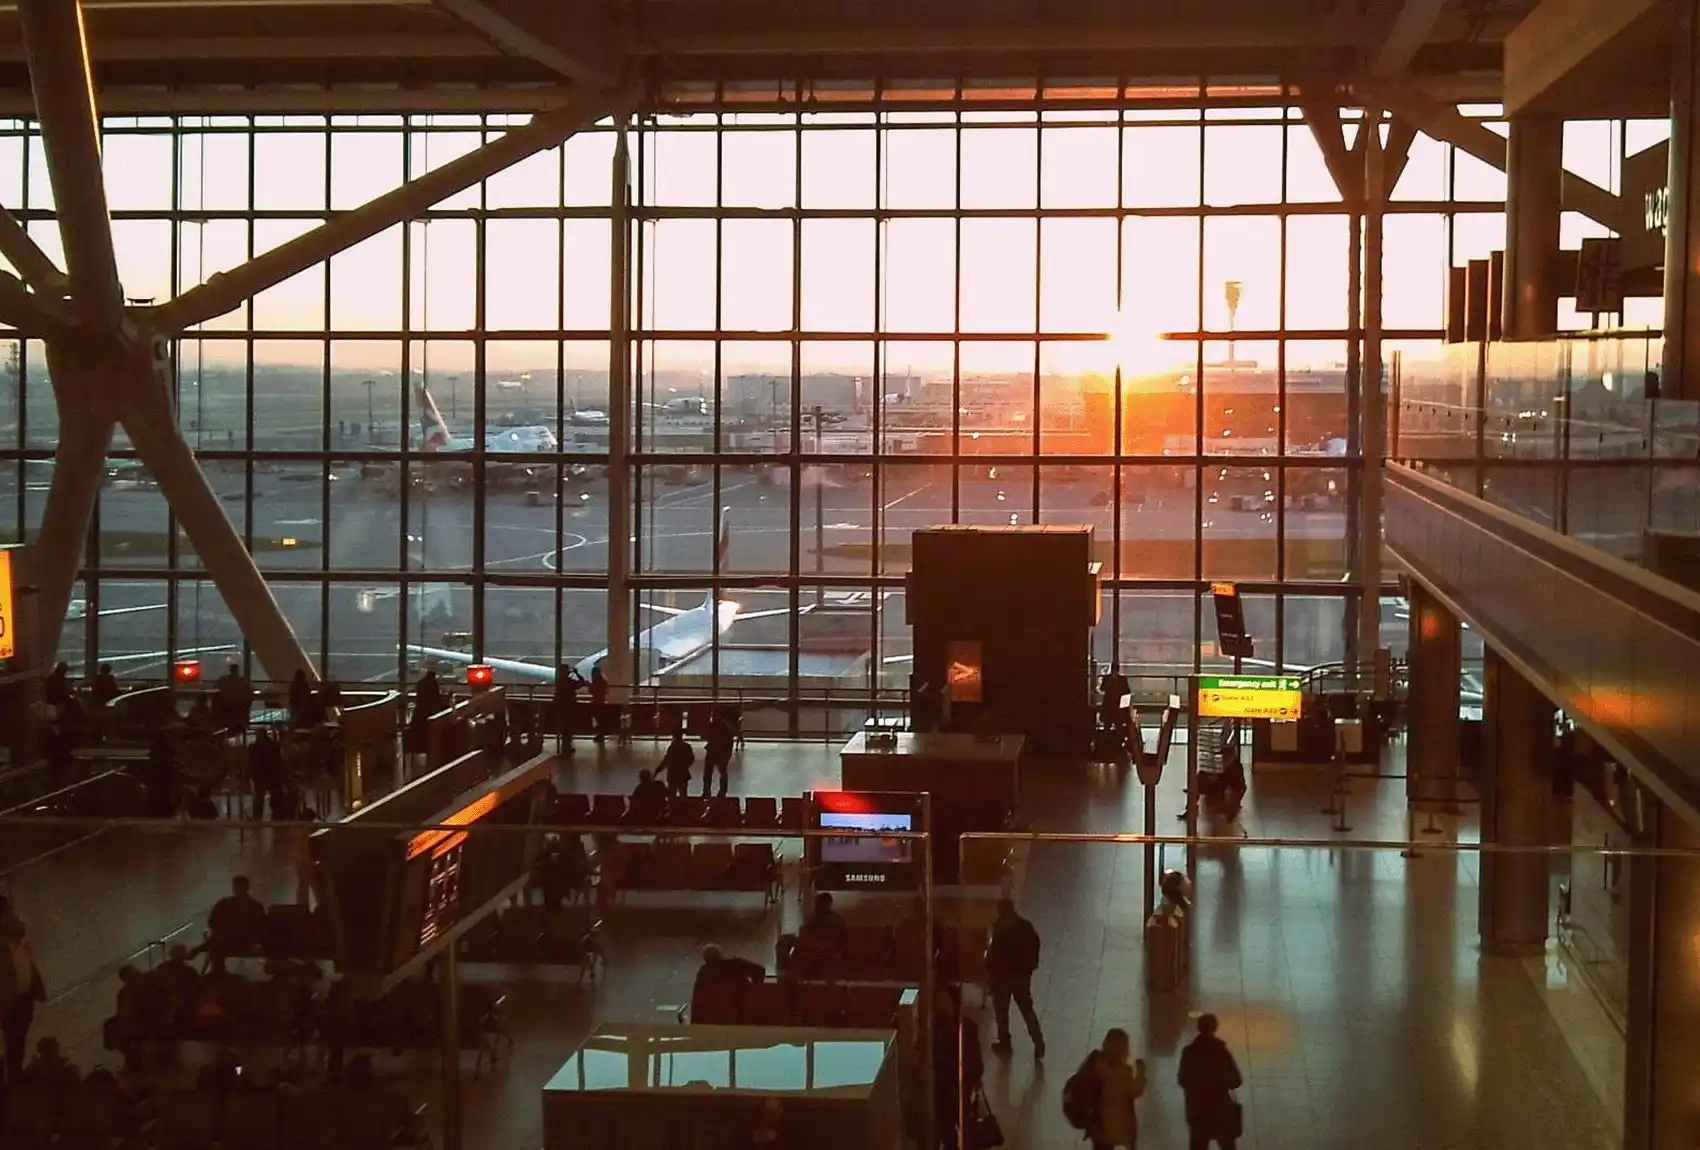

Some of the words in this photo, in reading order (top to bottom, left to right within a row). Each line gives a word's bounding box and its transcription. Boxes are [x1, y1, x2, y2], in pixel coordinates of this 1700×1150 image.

[1218, 679, 1260, 689] Emergency
[1261, 680, 1277, 689] exit
[845, 874, 885, 882] SAMSUNG
